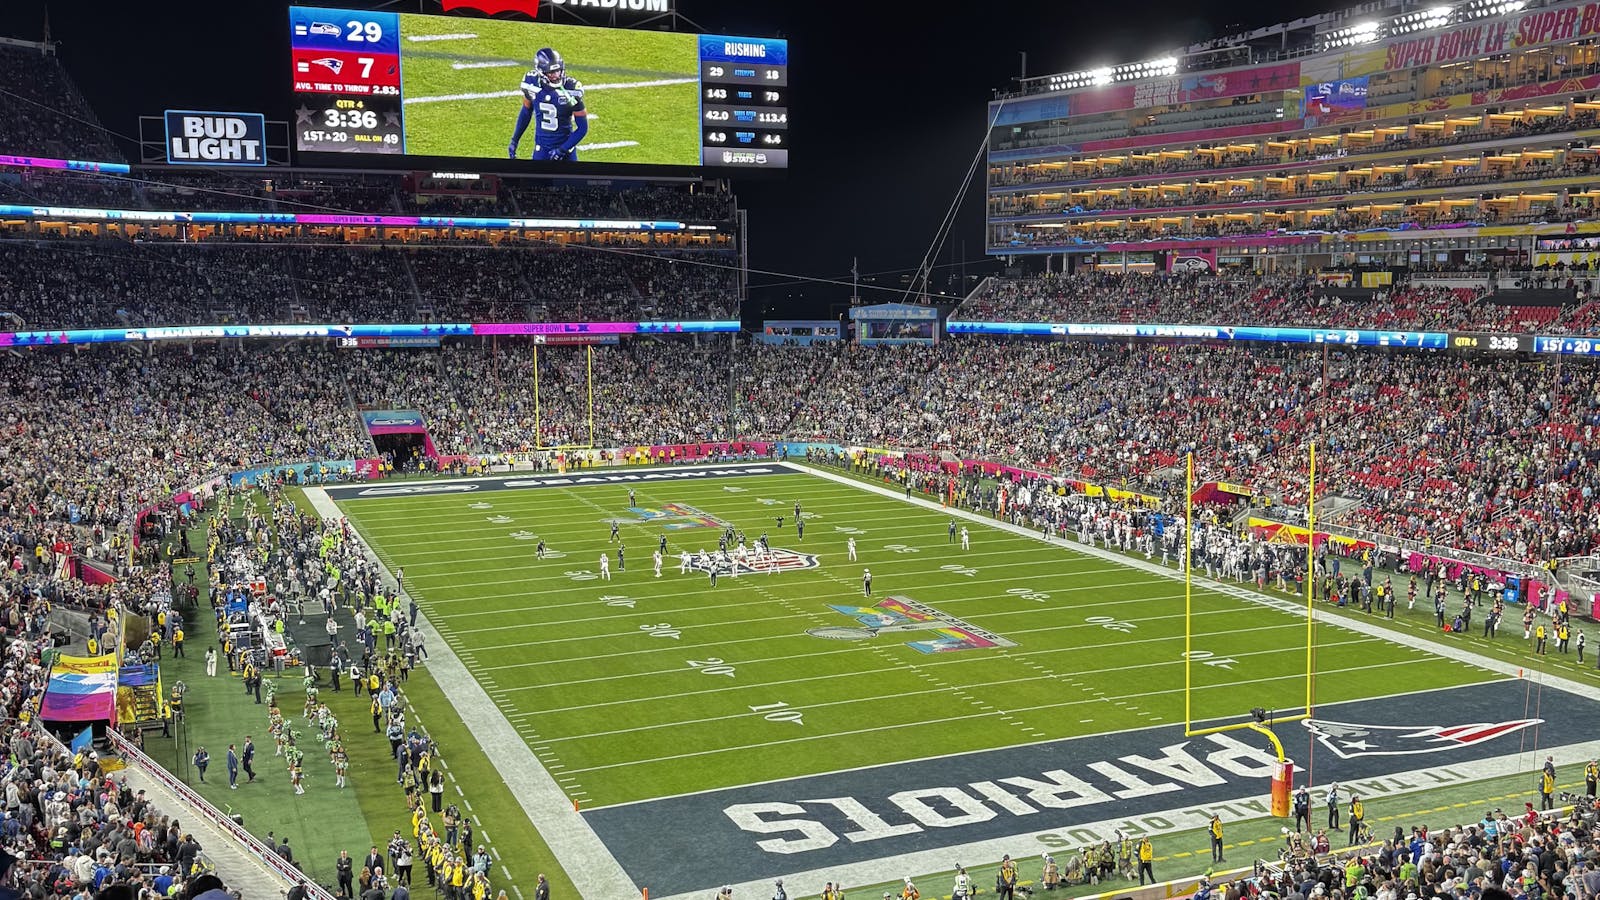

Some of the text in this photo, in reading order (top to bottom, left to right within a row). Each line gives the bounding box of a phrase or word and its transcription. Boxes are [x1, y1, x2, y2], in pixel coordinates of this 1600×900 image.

[346, 20, 383, 43] 29
[1515, 7, 1578, 47] SUPER
[724, 42, 766, 58] RUSHING
[1384, 22, 1507, 70] SUPER BOWL LX
[358, 57, 374, 79] 7
[709, 66, 724, 77] 29
[295, 82, 313, 90] AVG.
[314, 83, 332, 91] TIME
[344, 84, 370, 92] THROW
[707, 88, 727, 99] 143
[766, 91, 780, 102] 79
[336, 100, 364, 109] QTR 4
[324, 109, 378, 129] 3:36
[539, 102, 559, 131] 3
[705, 110, 729, 120] 42.0
[759, 113, 787, 123] 113.4
[183, 116, 247, 139] BUD
[303, 131, 325, 142] 1ST
[332, 132, 347, 142] 20
[383, 134, 399, 144] 49
[709, 132, 727, 142] 4.9
[764, 134, 782, 144] 4.4
[523, 324, 544, 332] SUPER
[546, 324, 562, 332] BOWL
[535, 335, 546, 343] 24
[1345, 331, 1360, 343] 29
[1417, 334, 1425, 346] 7
[1455, 337, 1478, 347] QTR 4
[1489, 336, 1519, 350] 3:36
[1542, 339, 1565, 351] 1ST
[1574, 340, 1591, 352] 20
[502, 451, 526, 462] SPER
[1006, 588, 1050, 602] 30
[639, 622, 682, 638] 30
[1085, 616, 1138, 633] 20
[686, 657, 736, 676] 20
[1181, 650, 1240, 670] 10
[748, 701, 803, 722] 10
[1423, 768, 1469, 783] IT
[723, 733, 1305, 854] PATRIOTS
[1035, 828, 1104, 848] US
